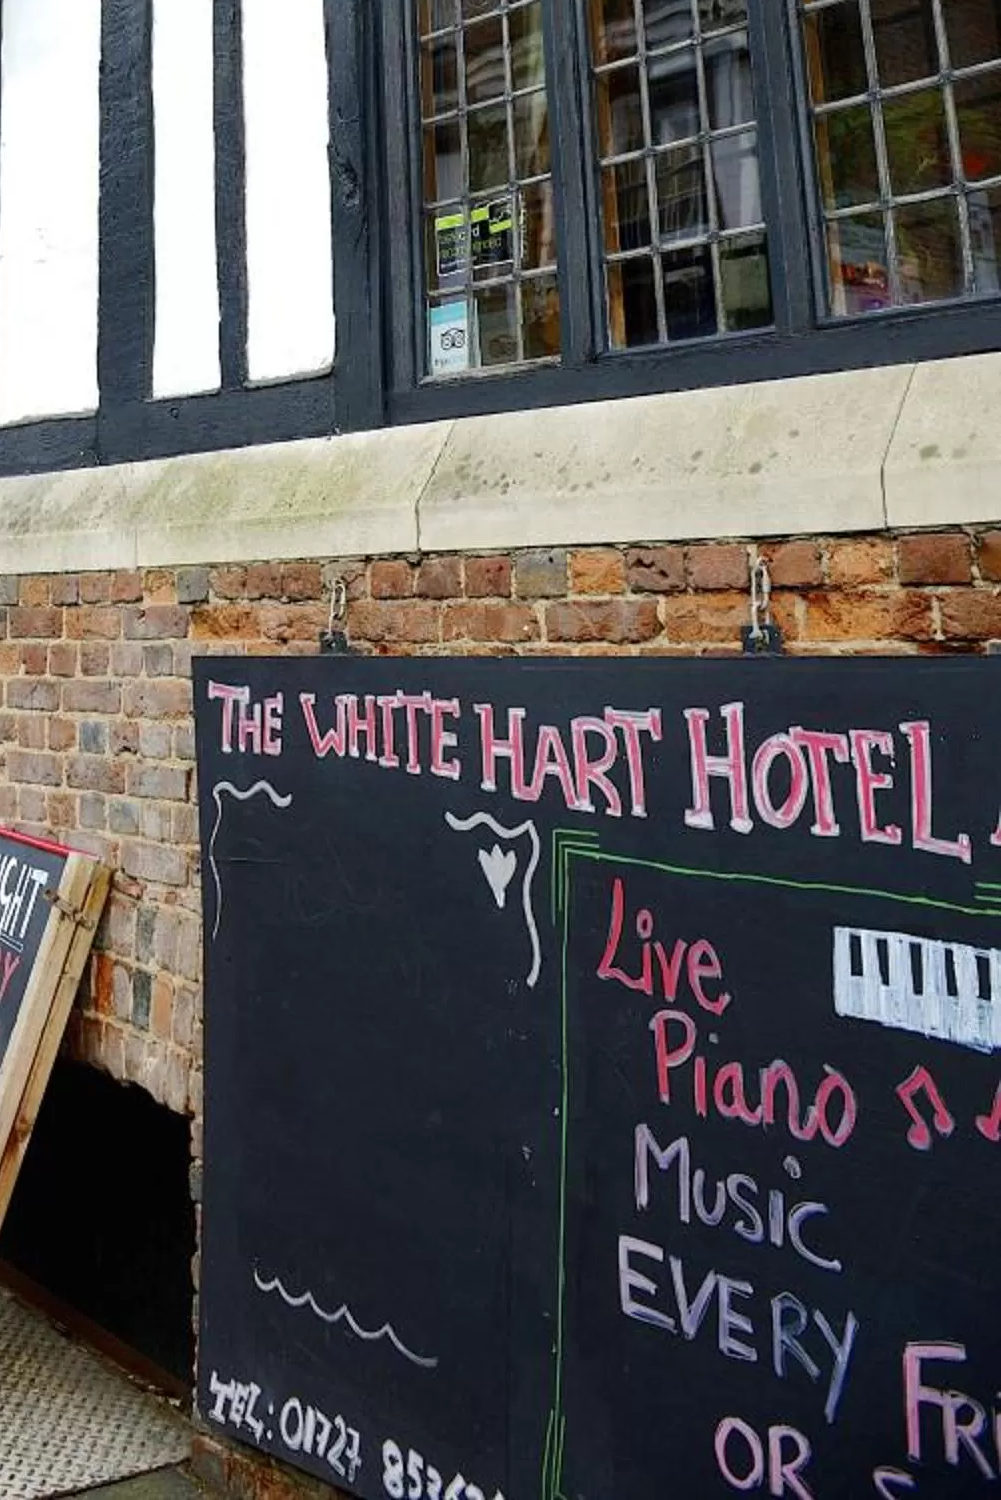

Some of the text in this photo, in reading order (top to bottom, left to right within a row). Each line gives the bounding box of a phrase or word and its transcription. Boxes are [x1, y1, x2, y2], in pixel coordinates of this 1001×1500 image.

[208, 681, 284, 757] THE
[300, 690, 462, 780] WHITE
[473, 702, 662, 819] HART
[684, 701, 973, 865] HOTEL
[596, 878, 732, 1015] Live
[648, 1008, 857, 1148] Piano
[618, 1234, 860, 1424] EVERY
[280, 1397, 362, 1483] 01727
[714, 1416, 814, 1500] OR
